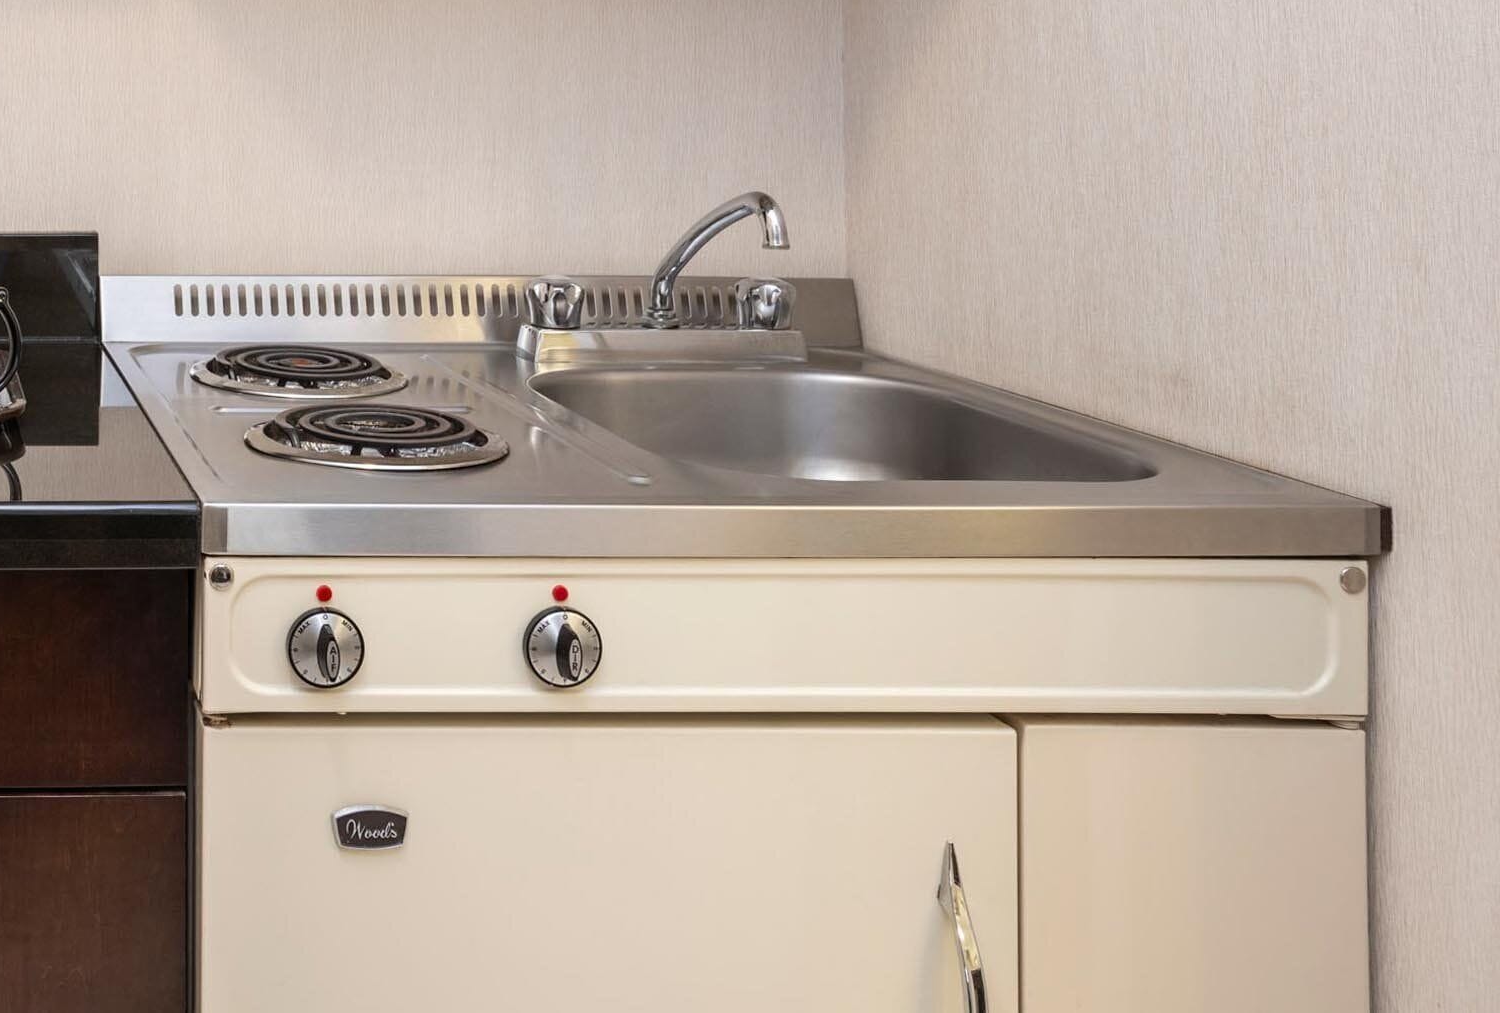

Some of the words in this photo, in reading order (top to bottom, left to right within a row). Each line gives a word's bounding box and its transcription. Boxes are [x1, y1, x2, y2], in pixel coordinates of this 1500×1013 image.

[298, 621, 311, 634] MAX
[341, 620, 353, 632] MIN
[537, 621, 550, 633] MAX
[581, 620, 592, 633] MIN
